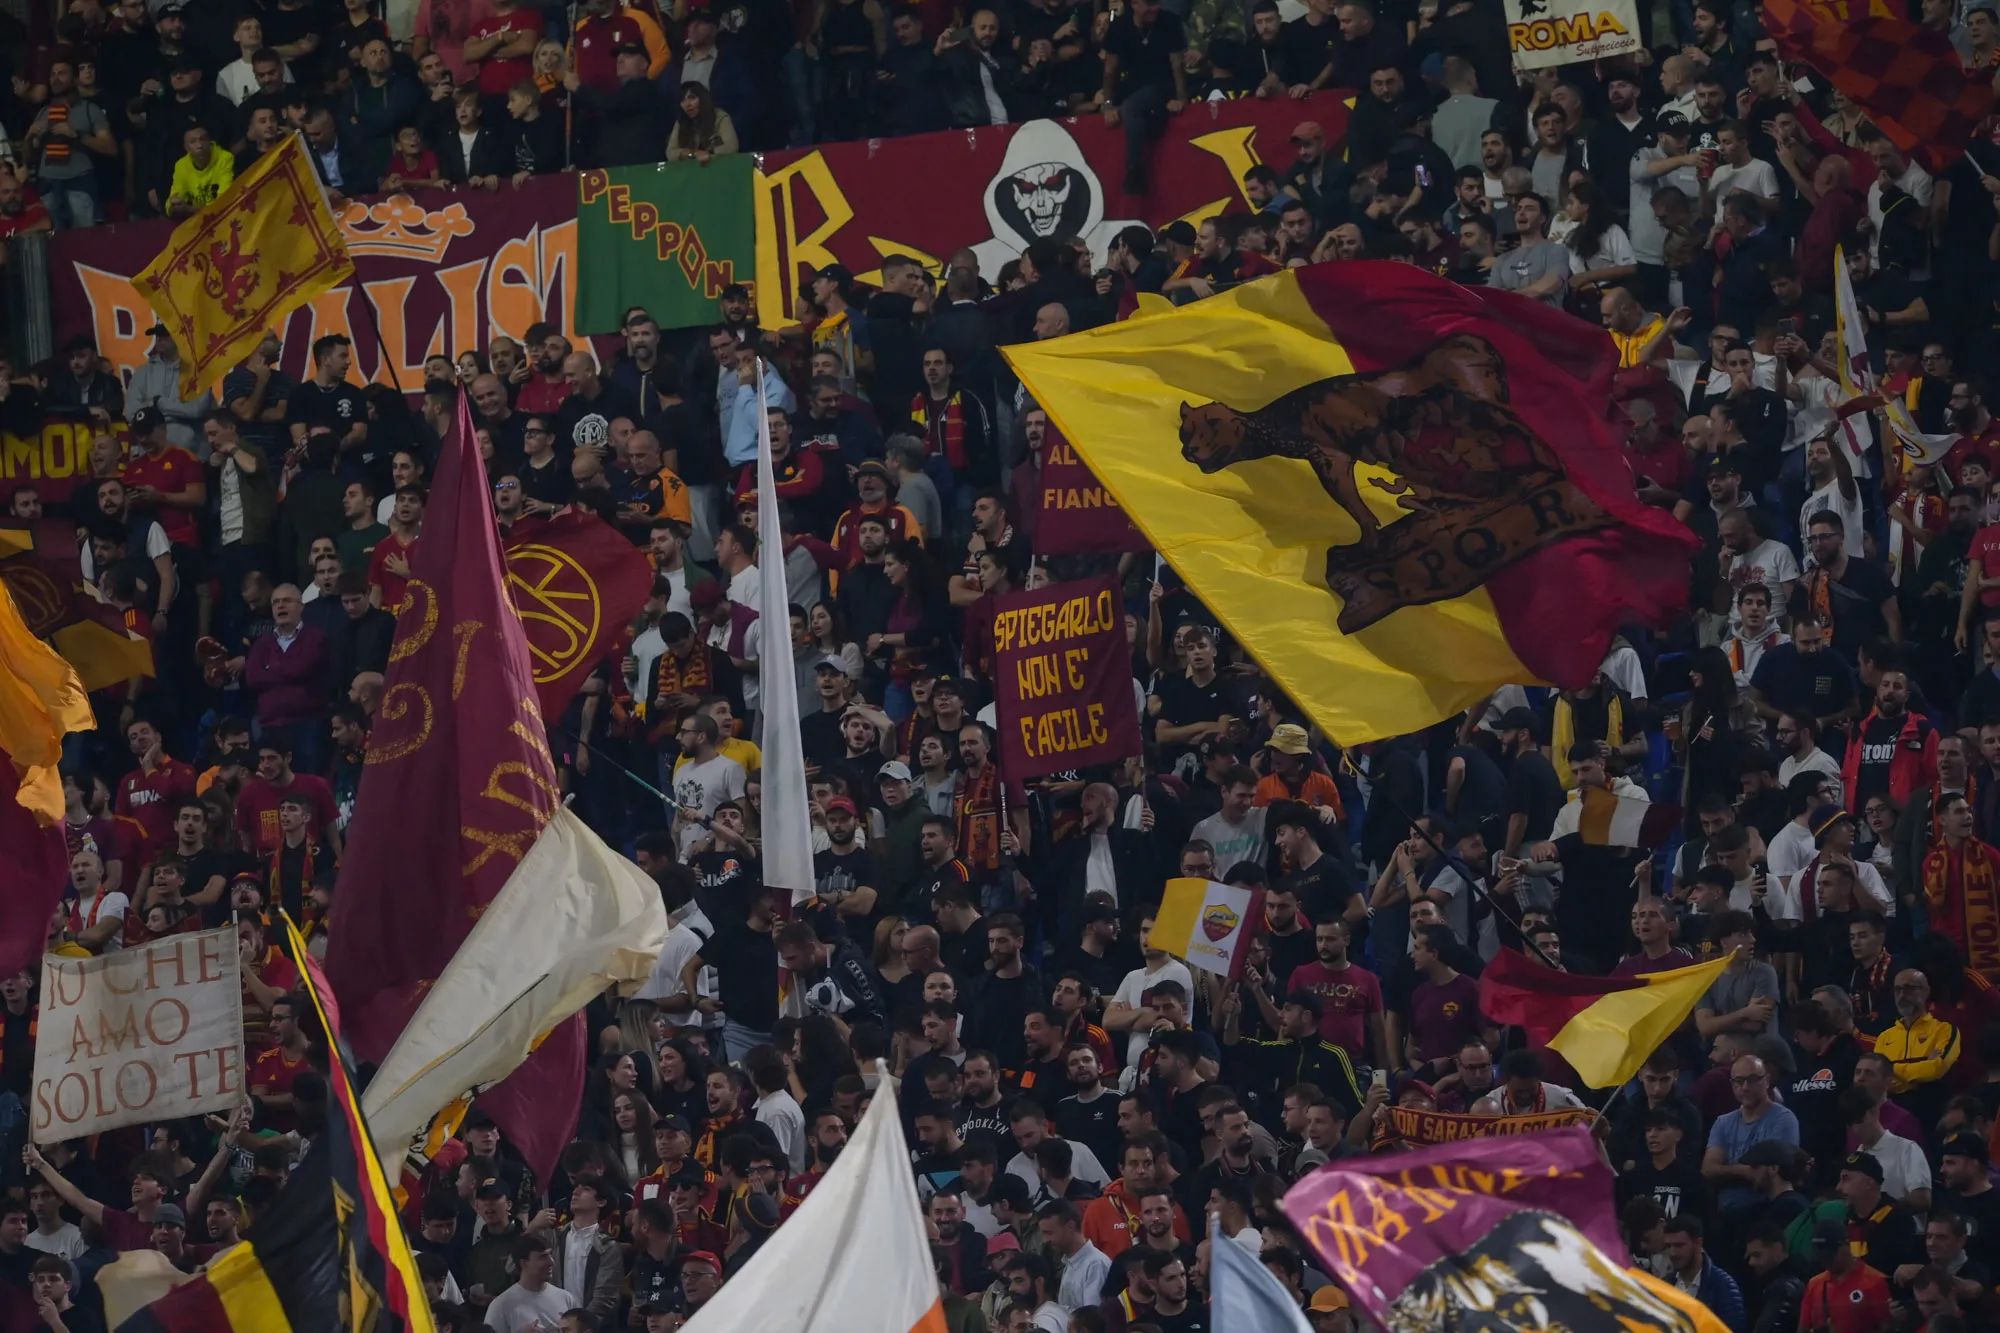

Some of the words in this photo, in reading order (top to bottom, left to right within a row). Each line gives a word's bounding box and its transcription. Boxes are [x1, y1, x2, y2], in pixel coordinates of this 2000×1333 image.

[1508, 11, 1629, 53] ROMA
[1048, 444, 1077, 466] AL
[994, 589, 1115, 653] SPIEGARLO
[1017, 652, 1063, 701] NON
[1064, 647, 1089, 691] E'
[1020, 702, 1109, 758] FACILE
[47, 960, 86, 1010] IO
[102, 934, 222, 995] CHE
[65, 997, 190, 1064] AMO
[36, 1058, 157, 1130] SOLO
[173, 1044, 239, 1100] TE
[1792, 1079, 1837, 1093] ellesse
[955, 1118, 1009, 1137] BROOKLYN
